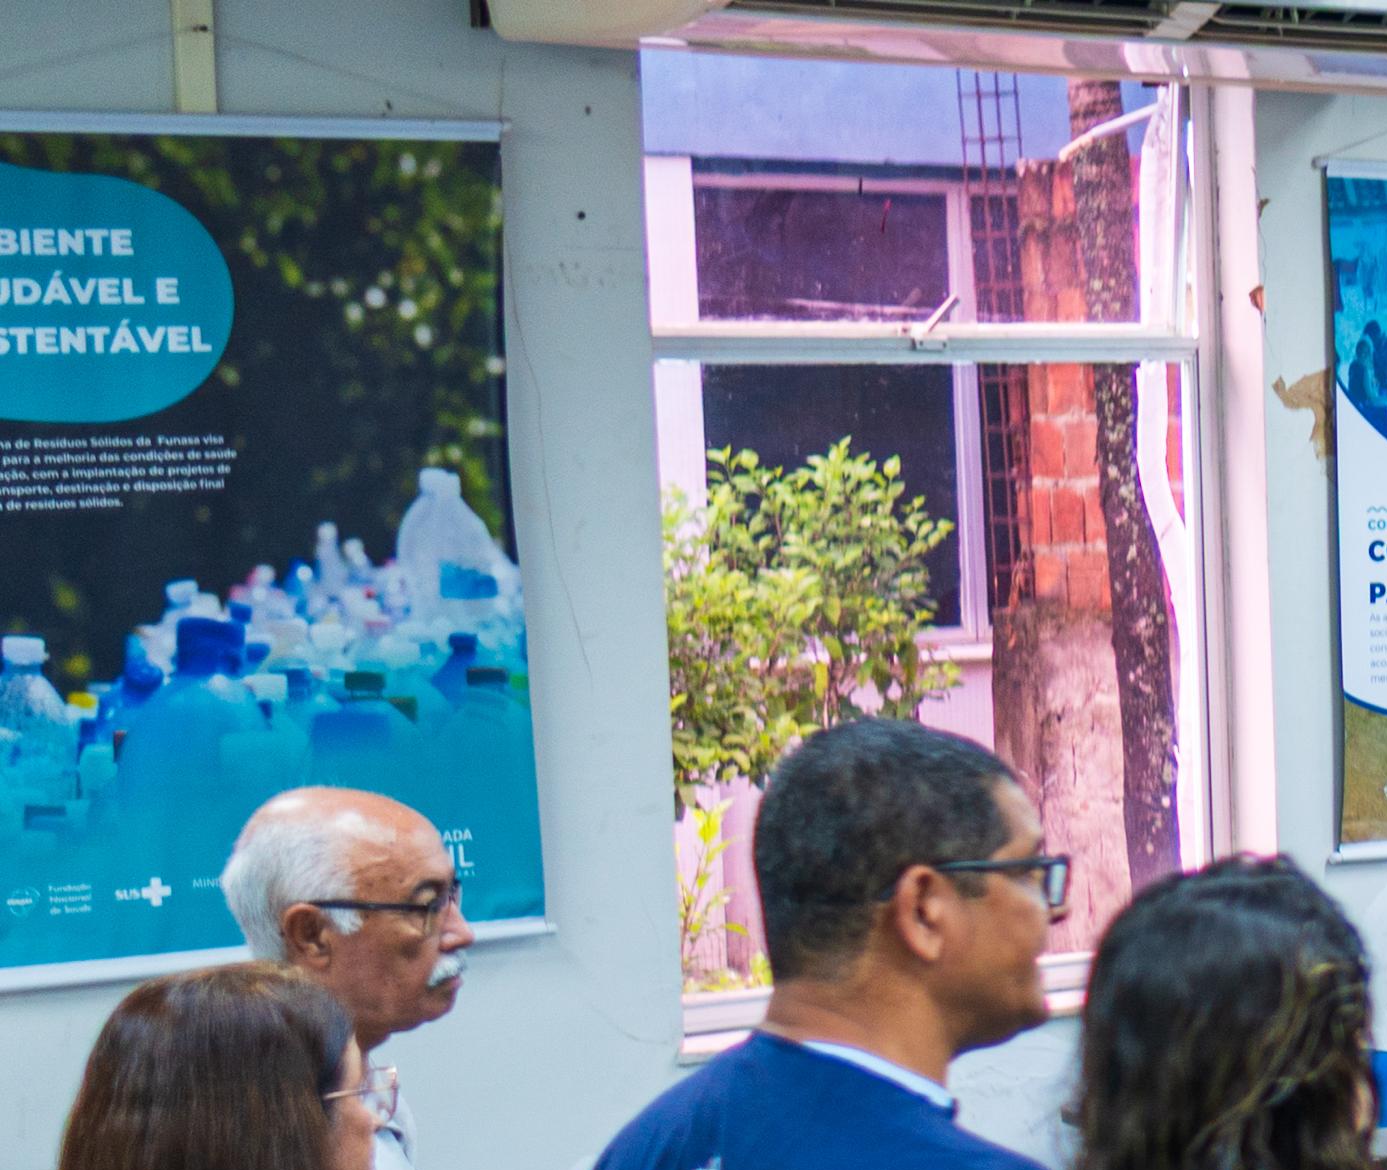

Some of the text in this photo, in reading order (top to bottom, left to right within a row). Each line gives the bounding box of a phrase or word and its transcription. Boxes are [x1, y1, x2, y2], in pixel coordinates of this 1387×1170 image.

[156, 277, 180, 304] E
[157, 434, 200, 446] Funasa
[44, 452, 96, 464] melhoria
[72, 466, 146, 480] implantação
[167, 464, 214, 478] projetos
[442, 828, 473, 843] ADA
[115, 888, 140, 900] SUS
